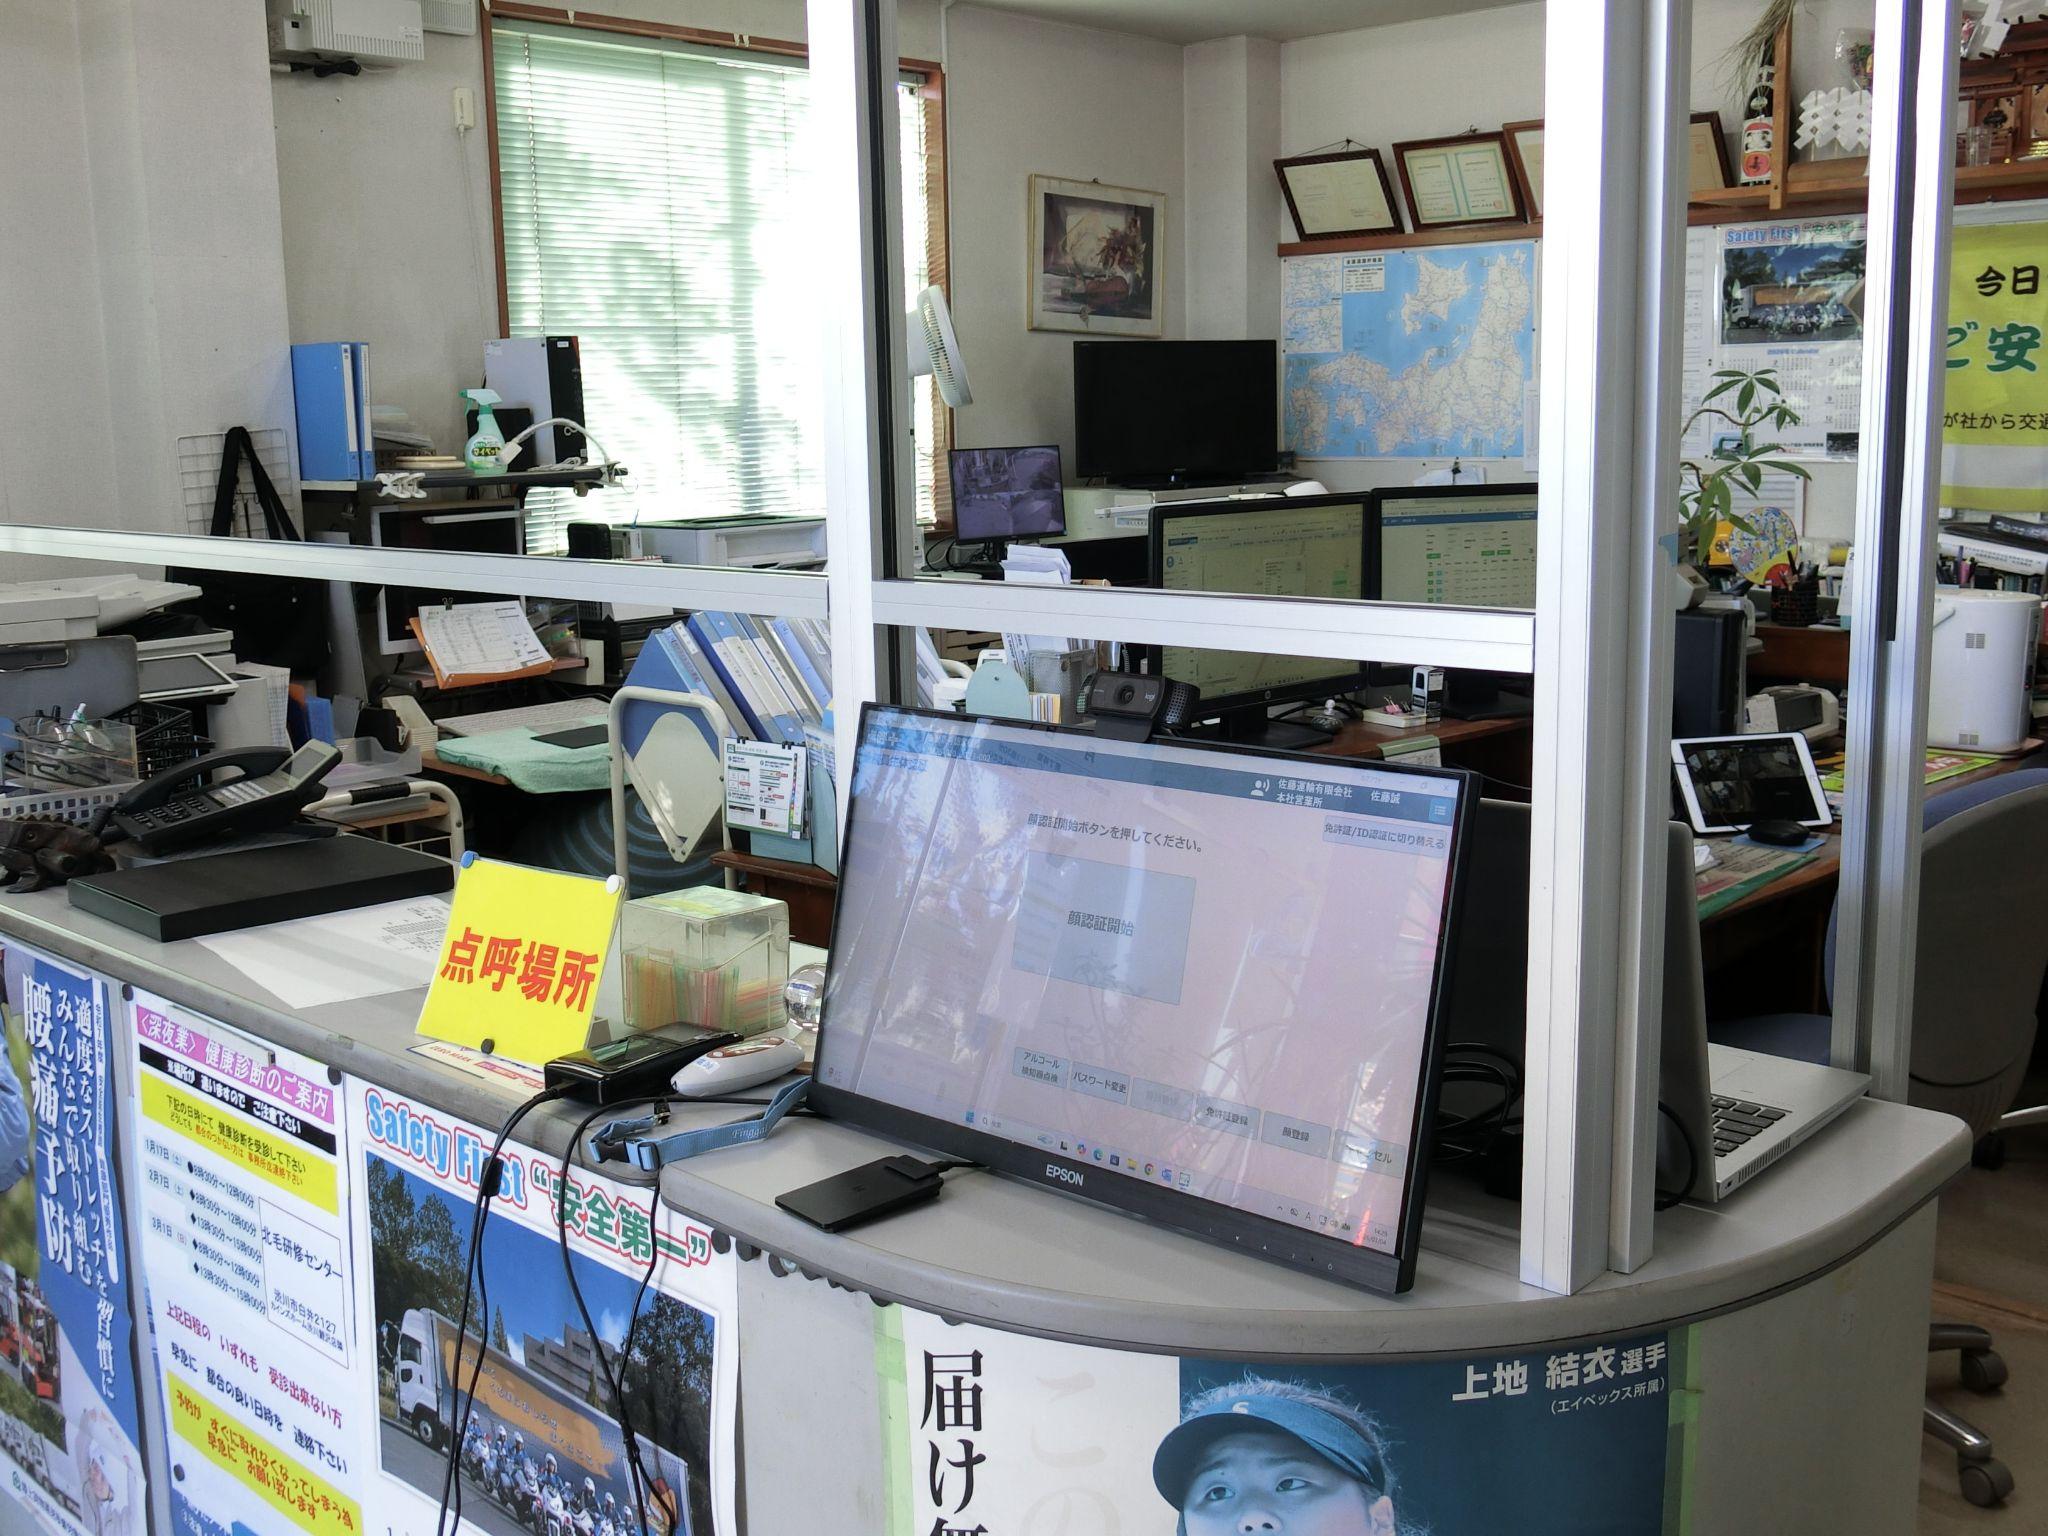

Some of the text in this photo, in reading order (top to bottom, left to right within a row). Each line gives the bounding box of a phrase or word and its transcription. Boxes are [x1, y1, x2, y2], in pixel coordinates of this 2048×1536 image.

[1944, 412, 2048, 431] が社から交
[1276, 792, 1323, 809] 本社営業所
[1278, 778, 1353, 798] 佐藤運輸有限会社
[1027, 813, 1202, 853] 顔認証開始ボタンを押してください。
[1324, 822, 1446, 850] 免許証/ID認証に切り替える
[1067, 910, 1134, 937] 顔認証開始
[441, 927, 599, 1012] 点呼場所
[205, 1040, 329, 1117] 健康診断のご案内
[1022, 1051, 1060, 1069] アルコール
[1073, 1071, 1127, 1094] パスワード変更
[23, 974, 73, 1275] 腰痛予防
[56, 988, 93, 1286] みんなで取り組む
[368, 1093, 450, 1174] Safety
[456, 1133, 527, 1207] Fist
[74, 995, 115, 1399] 適度なストレッチを習慣に
[1046, 1164, 1084, 1186] EPSON
[262, 1225, 344, 1280] 北毛研修センター
[167, 1300, 343, 1430] 上記日程の いずれも 受診出来ない方
[1452, 1341, 1666, 1401] 上地 結衣 選手
[171, 1341, 348, 1475] 早急に 都合の良い日時を 連絡下さい
[1551, 1376, 1665, 1415] （エイベックス所属）
[920, 1349, 989, 1536] 届け
[246, 1460, 317, 1521] お願い致します
